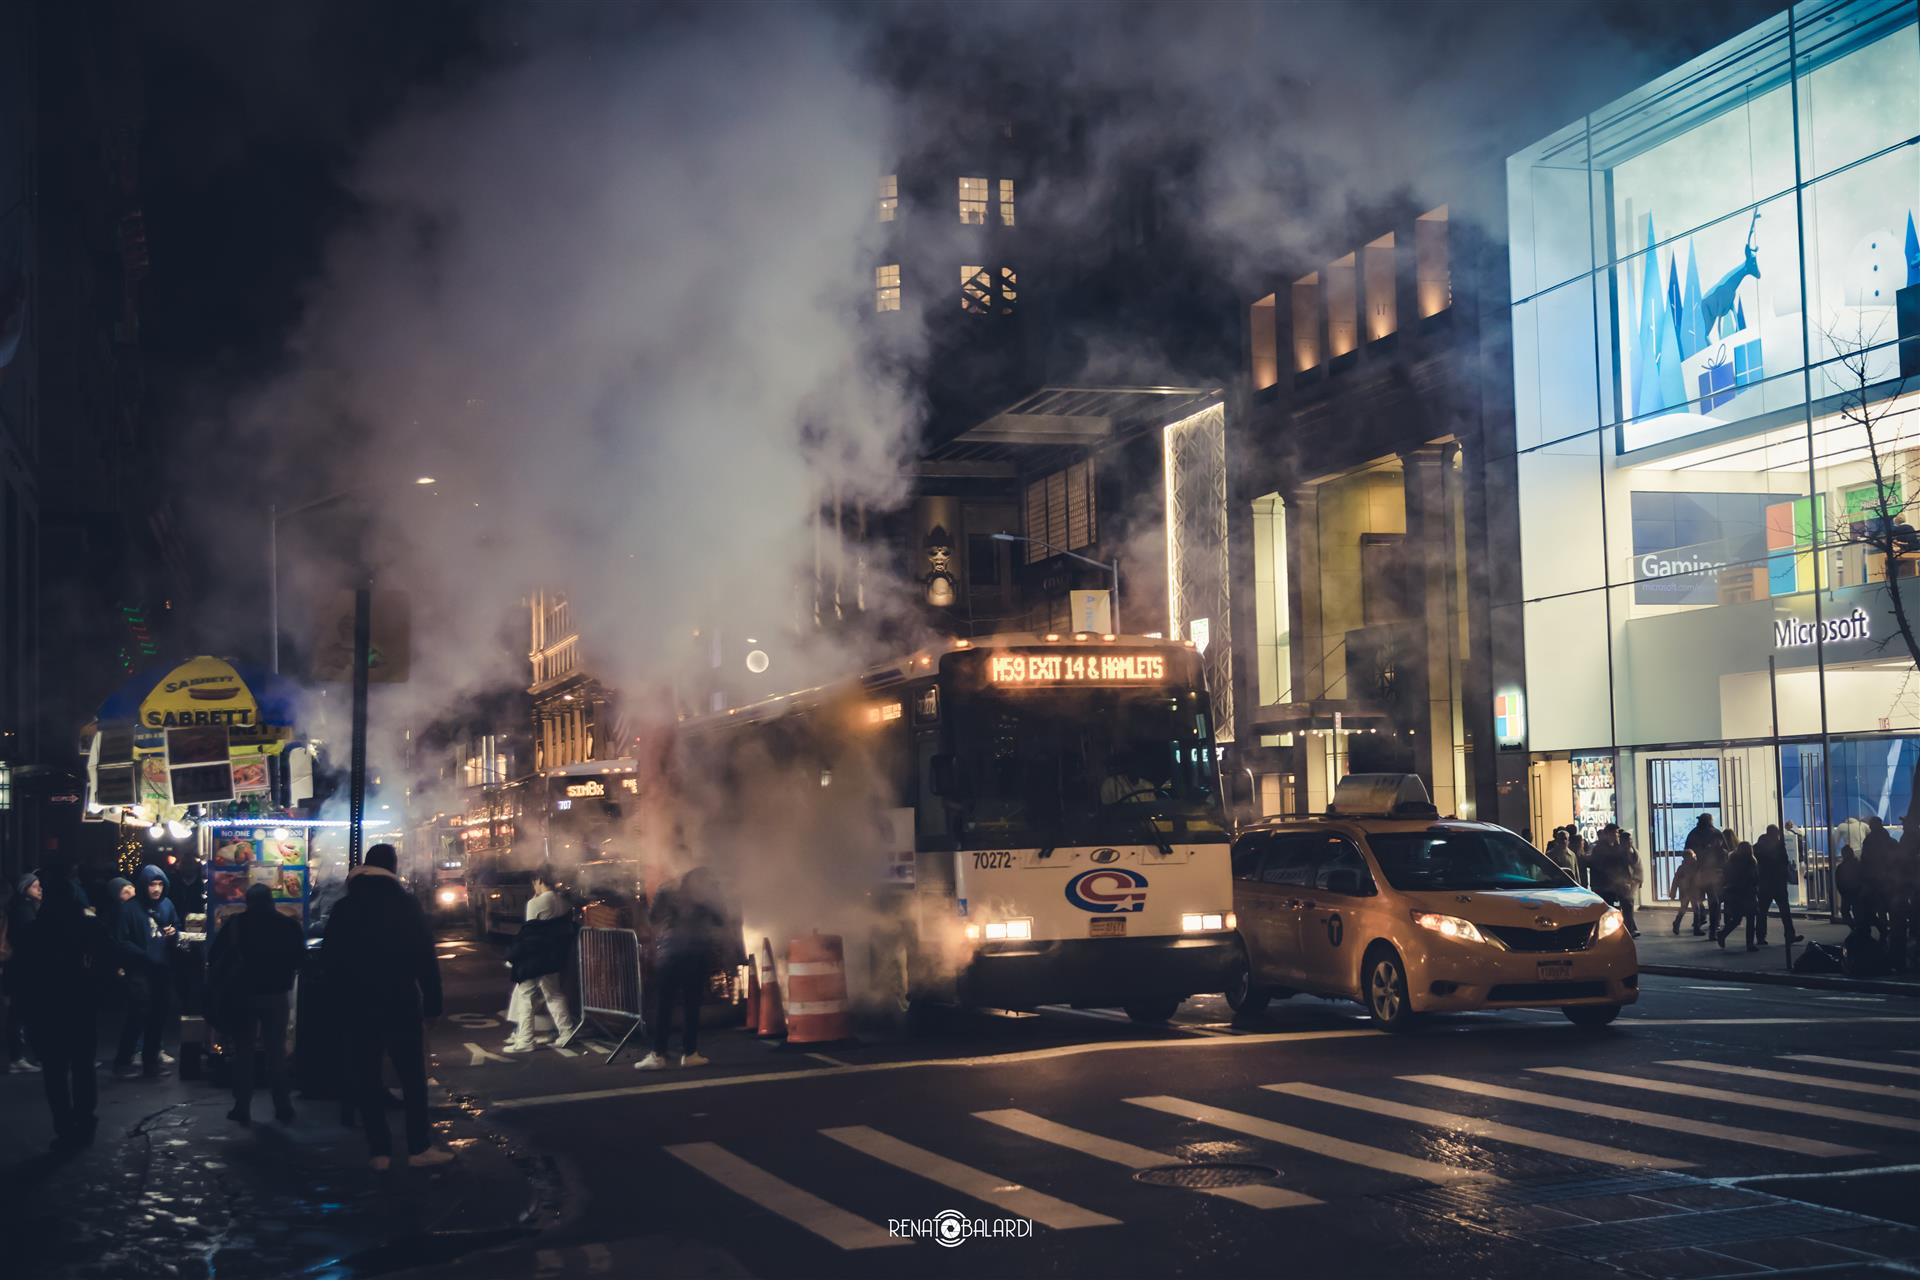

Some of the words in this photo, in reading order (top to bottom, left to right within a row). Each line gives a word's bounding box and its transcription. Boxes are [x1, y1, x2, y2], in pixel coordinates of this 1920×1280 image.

[1774, 608, 1869, 648] Microsoft
[992, 656, 1025, 681] M59
[1028, 656, 1062, 680] EXIT
[1065, 656, 1085, 680] 14
[1087, 656, 1099, 680] &
[1101, 656, 1164, 679] HAMLETS
[147, 708, 252, 728] SABRETT
[566, 781, 605, 797] SIM8X
[1578, 775, 1610, 788] CREATE
[1580, 811, 1612, 824] DESIGN
[972, 851, 1012, 870] 70272
